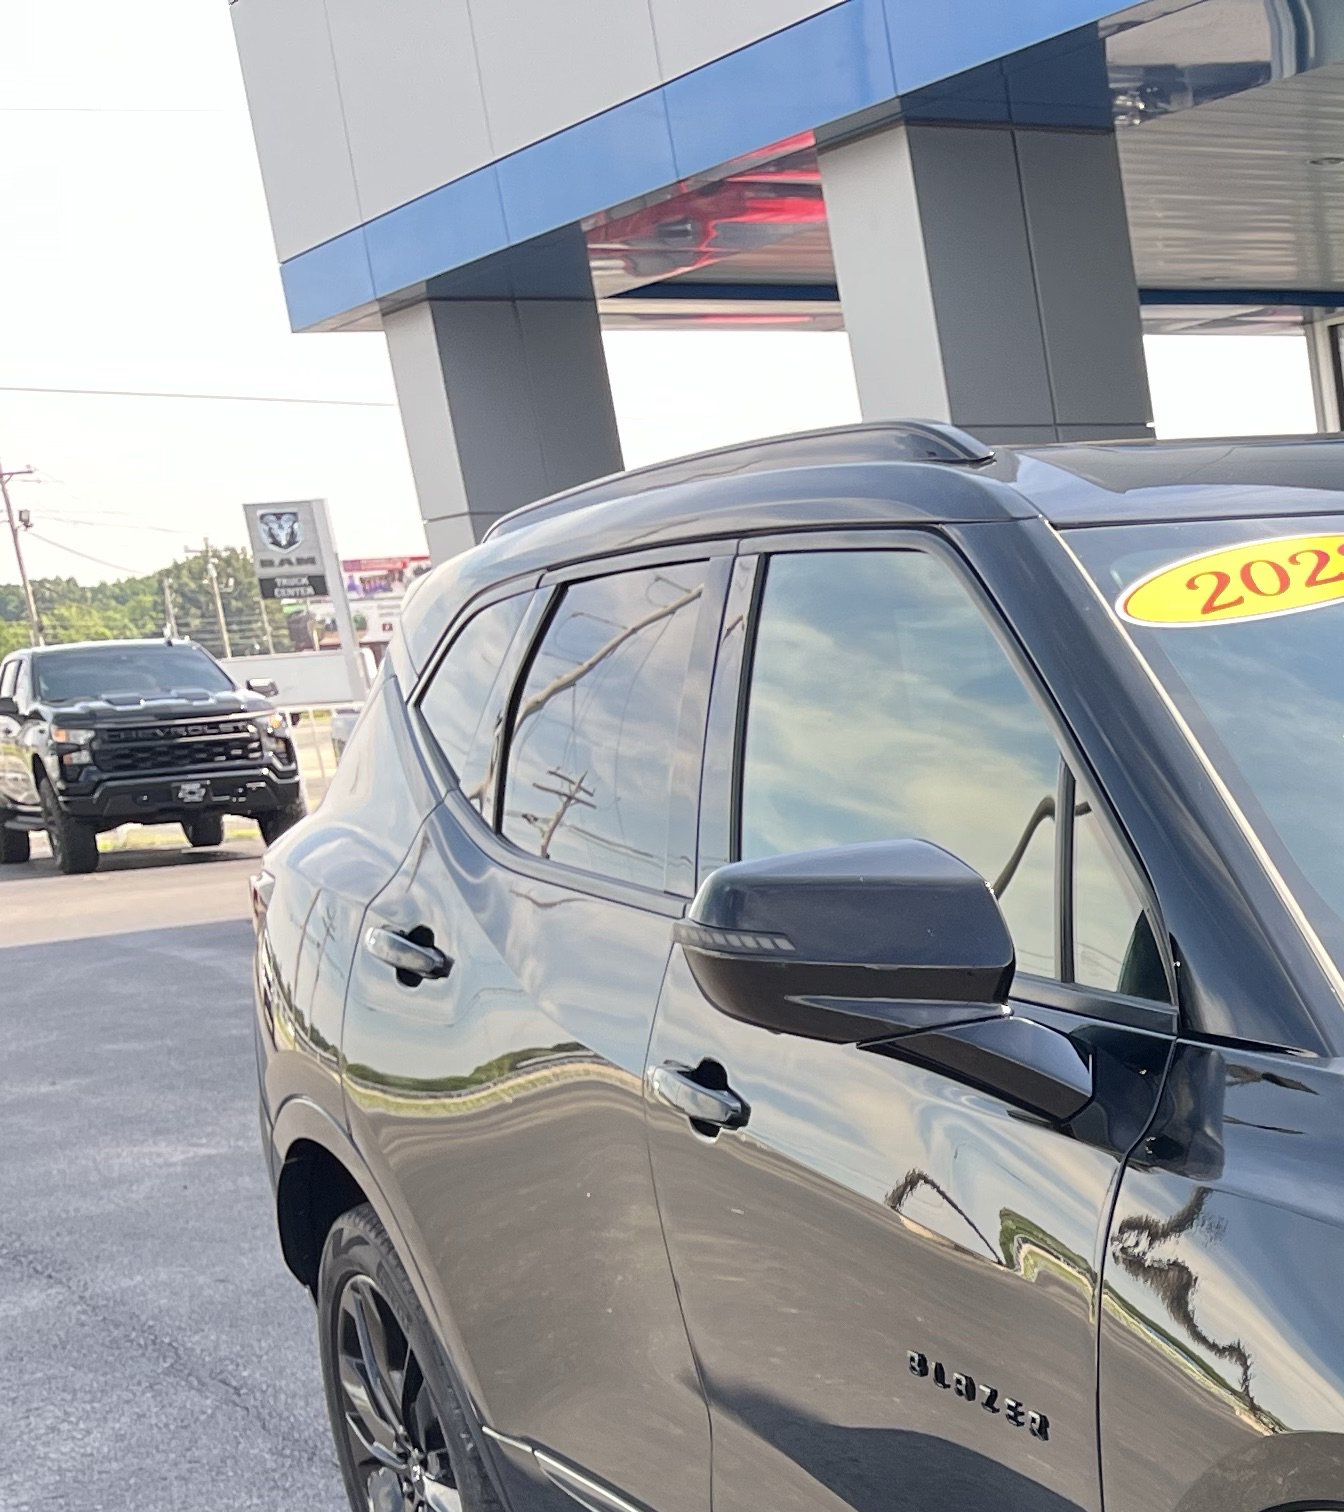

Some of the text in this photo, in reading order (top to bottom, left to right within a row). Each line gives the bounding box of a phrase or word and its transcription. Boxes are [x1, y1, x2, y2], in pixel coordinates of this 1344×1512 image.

[260, 556, 316, 568] RAM
[275, 576, 309, 587] TRUCK
[274, 586, 315, 598] CENTER
[906, 1350, 1050, 1441] BLAZER
